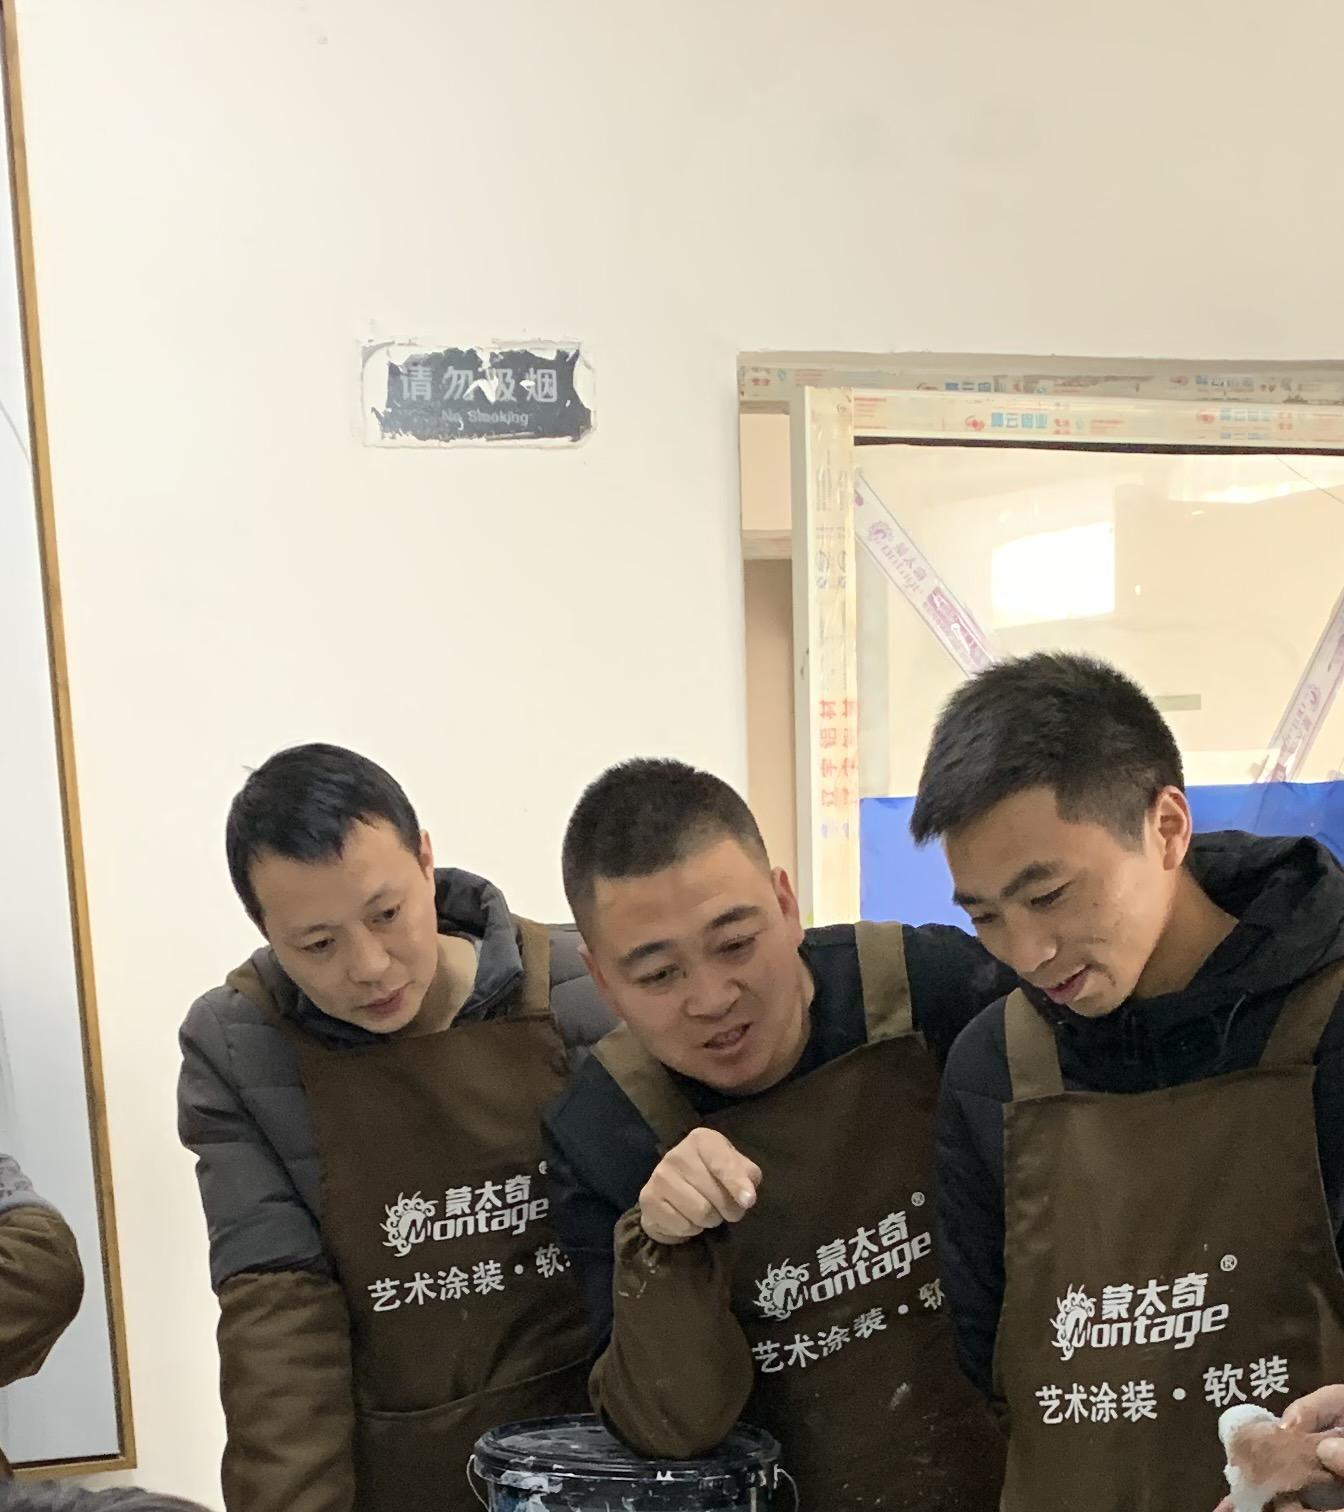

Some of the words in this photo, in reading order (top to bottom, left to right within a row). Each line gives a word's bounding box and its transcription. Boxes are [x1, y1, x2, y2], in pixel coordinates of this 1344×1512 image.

[468, 408, 530, 426] Smoking
[445, 1174, 532, 1218] 蒙太奇
[404, 1197, 550, 1244] Montage
[815, 1210, 909, 1277] 蒙太奇
[776, 1231, 932, 1311] Montage
[1101, 1272, 1209, 1320] 蒙太奇
[1064, 1303, 1229, 1350] Montage
